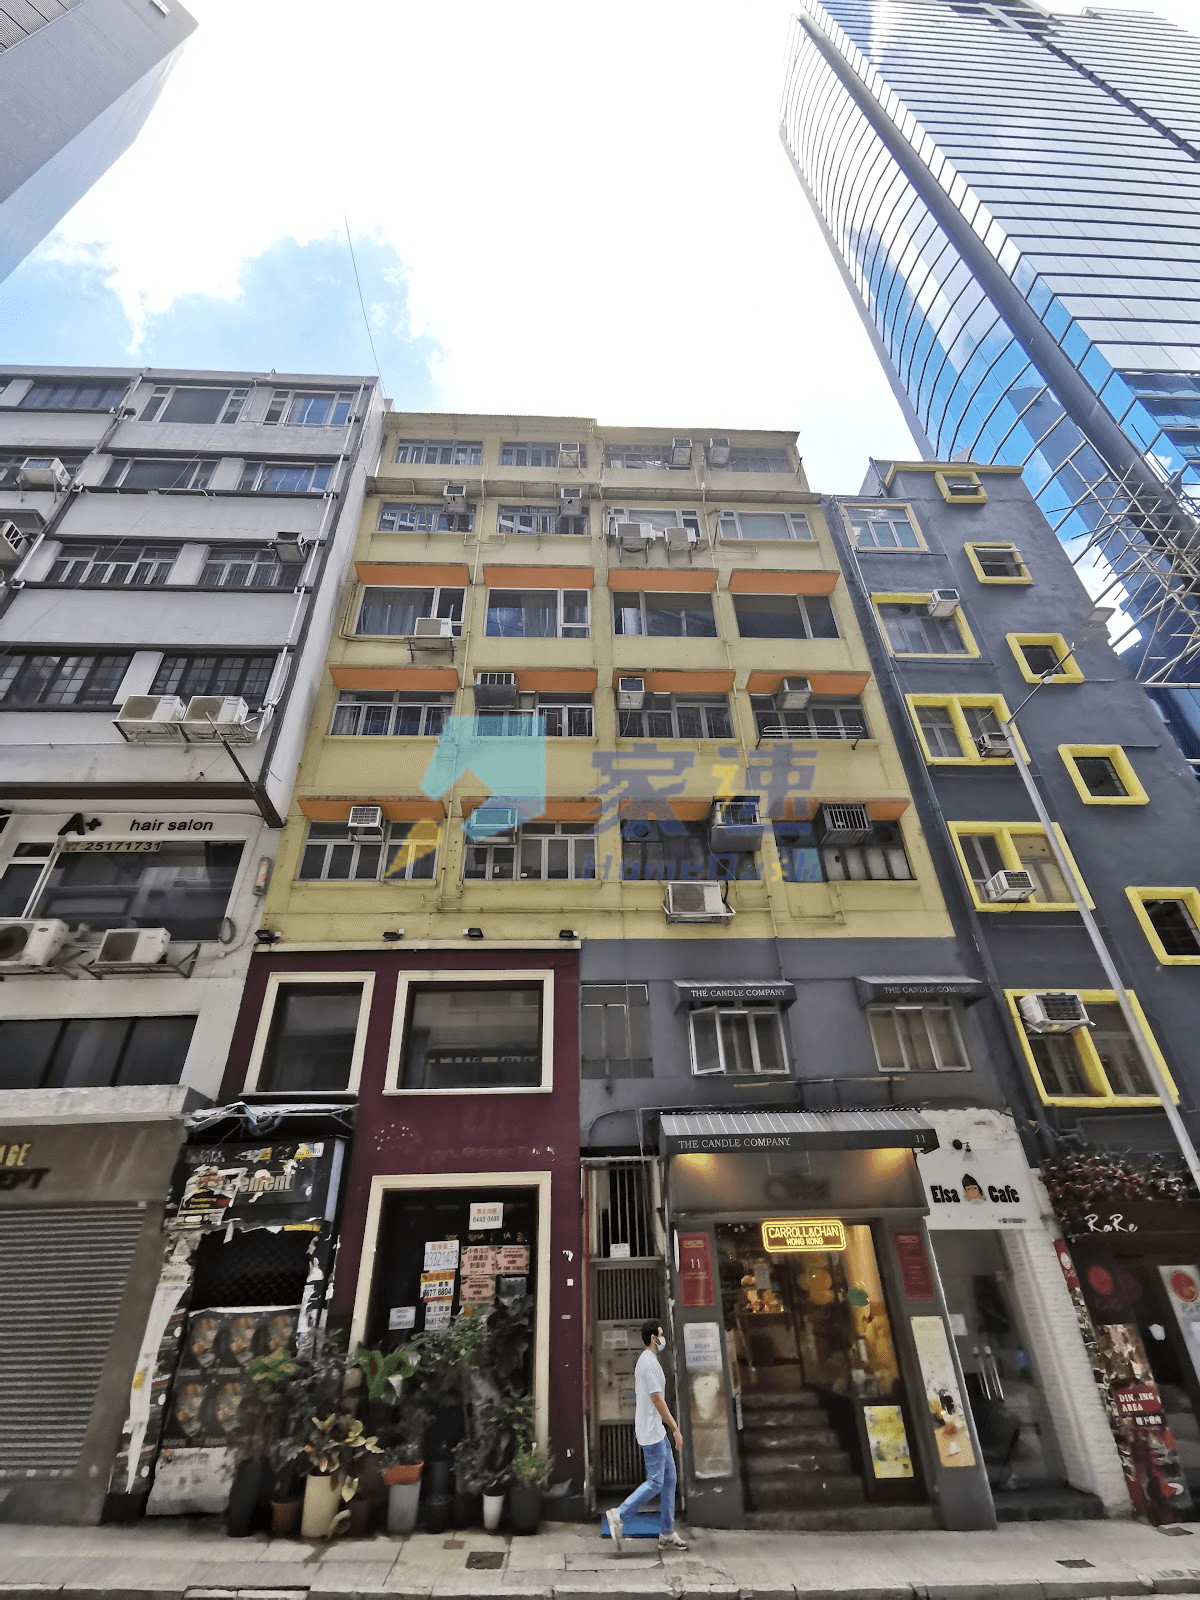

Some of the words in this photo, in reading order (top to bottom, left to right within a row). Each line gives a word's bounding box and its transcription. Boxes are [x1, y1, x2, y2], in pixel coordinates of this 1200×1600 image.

[57, 812, 102, 836] A+
[129, 819, 164, 831] hair
[167, 818, 213, 831] salon
[84, 841, 162, 851] 25171731
[690, 989, 709, 997] THE
[709, 989, 745, 997] CANDLE
[745, 988, 786, 996] COMPANY
[883, 986, 900, 994] THE
[901, 986, 935, 994] CANDLE
[677, 1140, 699, 1149] THE
[701, 1139, 742, 1148] CANDLE
[743, 1137, 791, 1147] COMPANY
[930, 1185, 961, 1203] Elsa
[988, 1184, 1020, 1203] Cafe
[1084, 1213, 1138, 1233] RaRe
[768, 1226, 839, 1238] CARROLL&CHAN
[786, 1237, 805, 1246] HONG
[806, 1236, 824, 1245] KONG
[690, 1259, 701, 1269] 11
[1122, 1403, 1144, 1412] AREA
